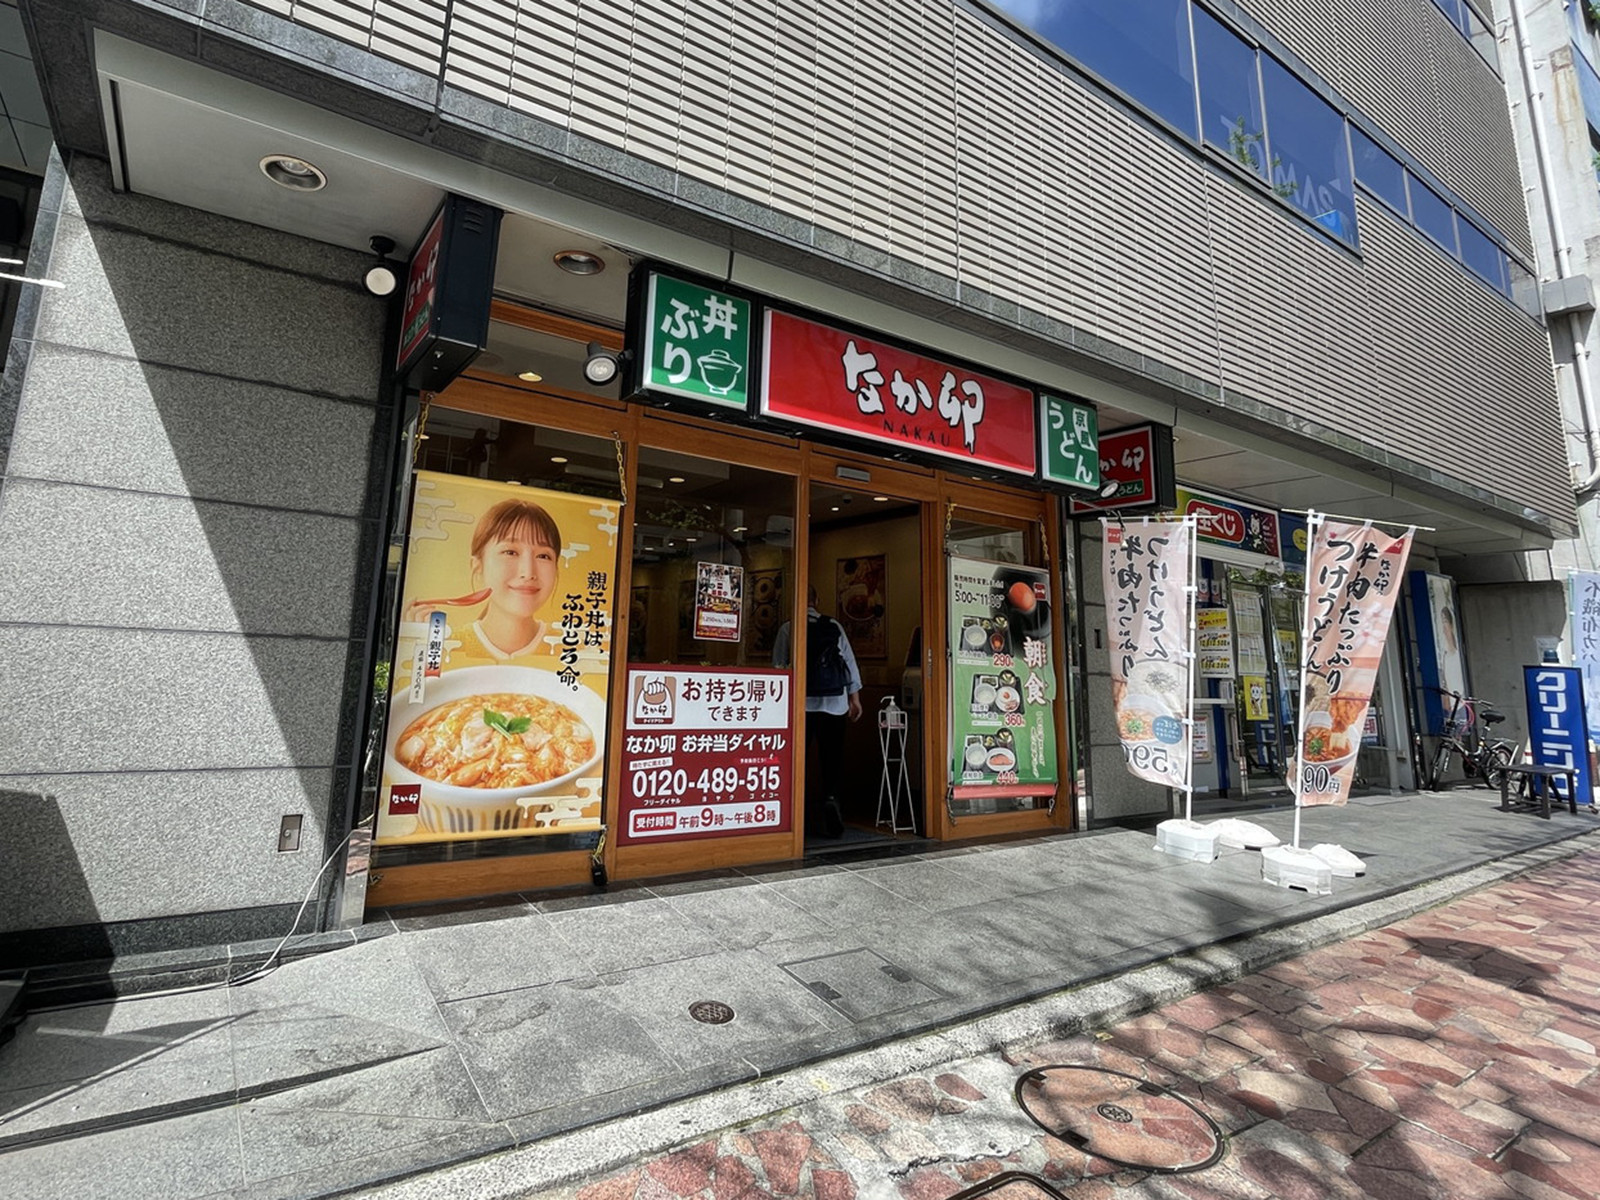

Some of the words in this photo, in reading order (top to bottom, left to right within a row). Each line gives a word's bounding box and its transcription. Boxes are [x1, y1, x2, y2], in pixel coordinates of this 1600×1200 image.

[702, 296, 739, 341] 丼
[661, 297, 699, 385] ぶり
[842, 339, 985, 455] なか卯
[883, 418, 951, 448] NAKAU
[1047, 403, 1093, 484] うどん
[1116, 484, 1142, 497] うどん
[1195, 507, 1236, 536] 宝くじ
[584, 571, 608, 655] 親子丼は、
[1305, 539, 1356, 671] つけうどん
[1325, 542, 1378, 695] 牛肉たっぷり
[556, 594, 585, 692] ふわとろ命。
[1023, 636, 1048, 705] 朝食
[681, 678, 784, 703] お持ち帰り
[708, 706, 762, 722] できます
[626, 735, 677, 754] なか卯
[682, 733, 786, 753] お弁当ダイヤル
[632, 766, 780, 798] 0120-489-515
[1301, 766, 1340, 793] 90円
[636, 815, 675, 829] 受付時間
